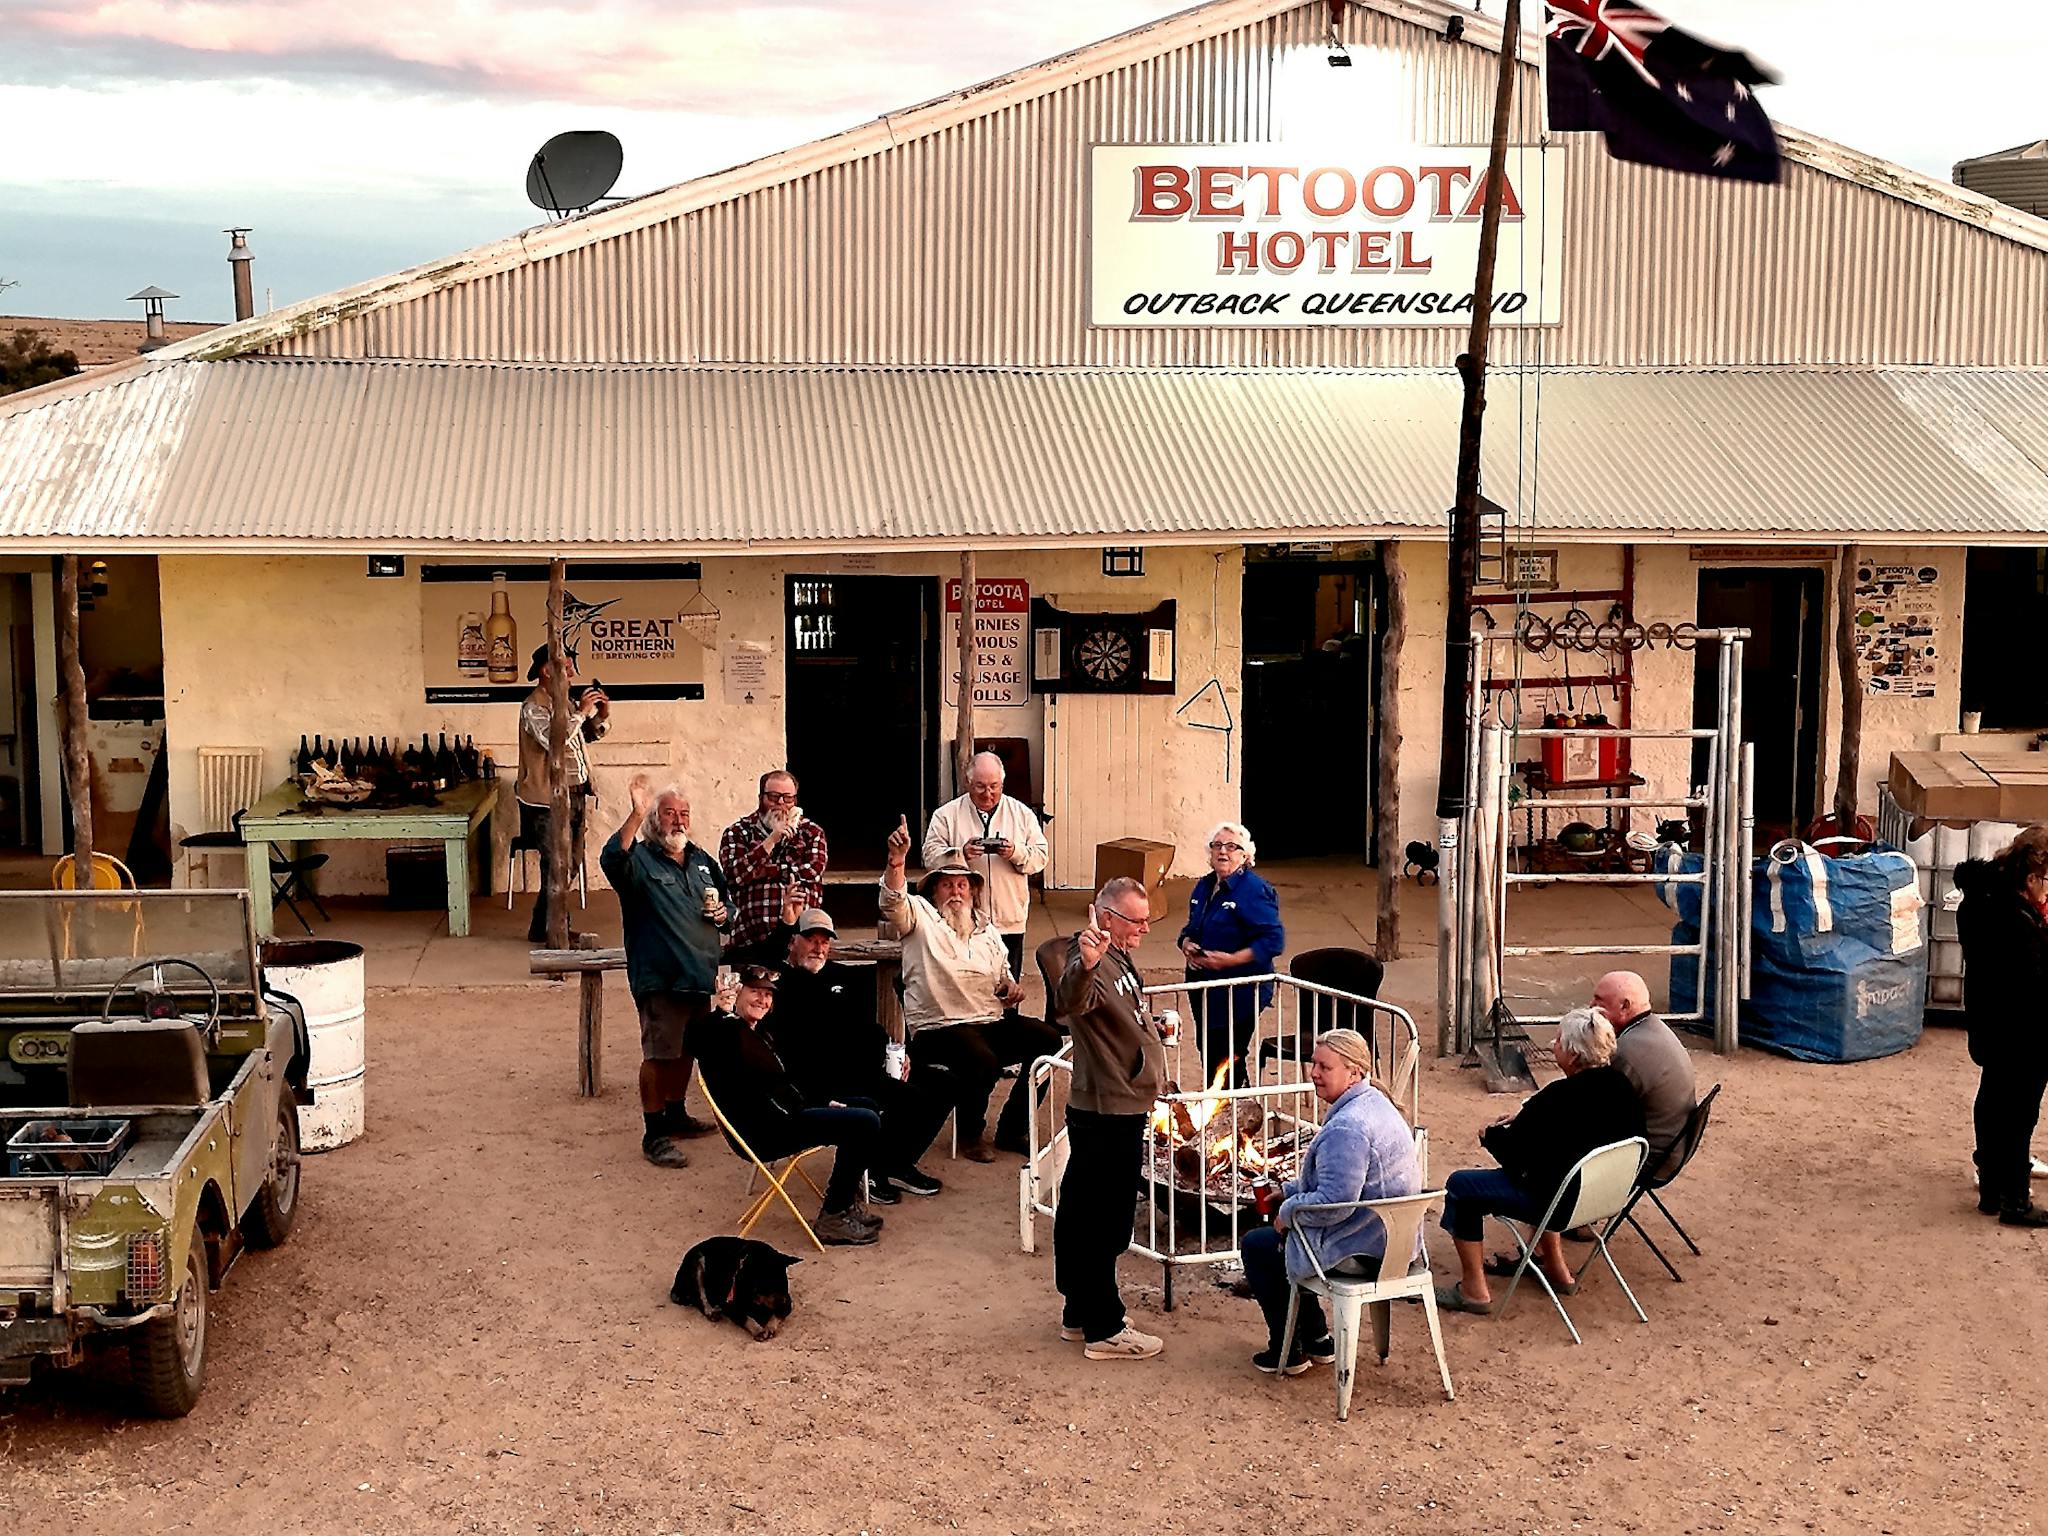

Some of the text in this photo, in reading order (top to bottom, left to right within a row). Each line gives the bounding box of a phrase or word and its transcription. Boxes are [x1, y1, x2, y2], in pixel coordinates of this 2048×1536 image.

[1130, 164, 1526, 222] BETOOTA
[1216, 231, 1432, 275] HOTEL
[1123, 292, 1290, 315] OUTBACK
[1876, 567, 1914, 576] BETOOTA
[952, 584, 1024, 601] BTOOTA
[590, 619, 674, 638] GREAT
[955, 618, 1020, 631] RNIES
[591, 639, 675, 652] NORTHERN
[956, 636, 1018, 649] MOUS
[606, 652, 648, 660] BREWING
[1001, 653, 1013, 666] &
[952, 671, 1021, 684] SUSAGE
[973, 689, 1012, 701] OLLS
